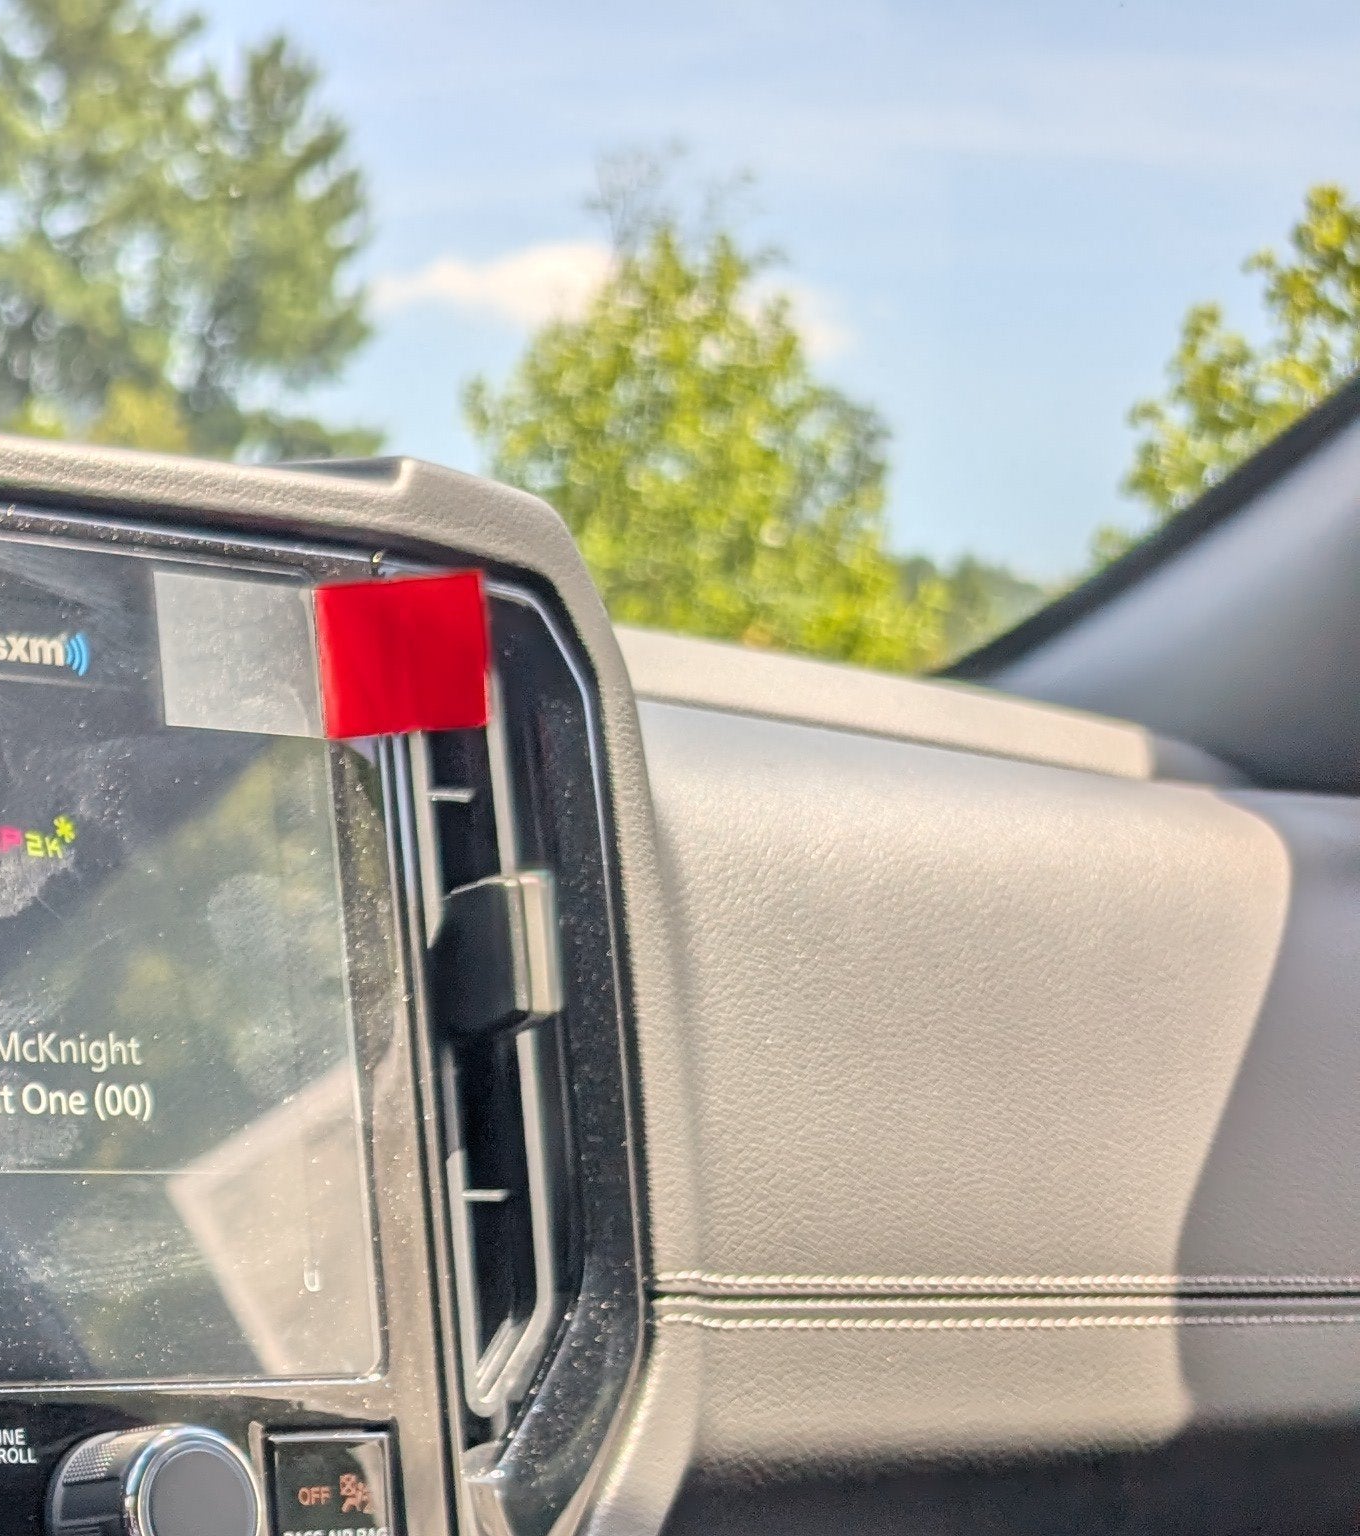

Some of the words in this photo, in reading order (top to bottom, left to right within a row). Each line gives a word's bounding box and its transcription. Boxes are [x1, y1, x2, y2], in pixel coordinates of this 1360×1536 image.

[19, 1084, 85, 1117] One
[94, 1082, 153, 1121] (00)
[298, 1485, 331, 1505] OFF
